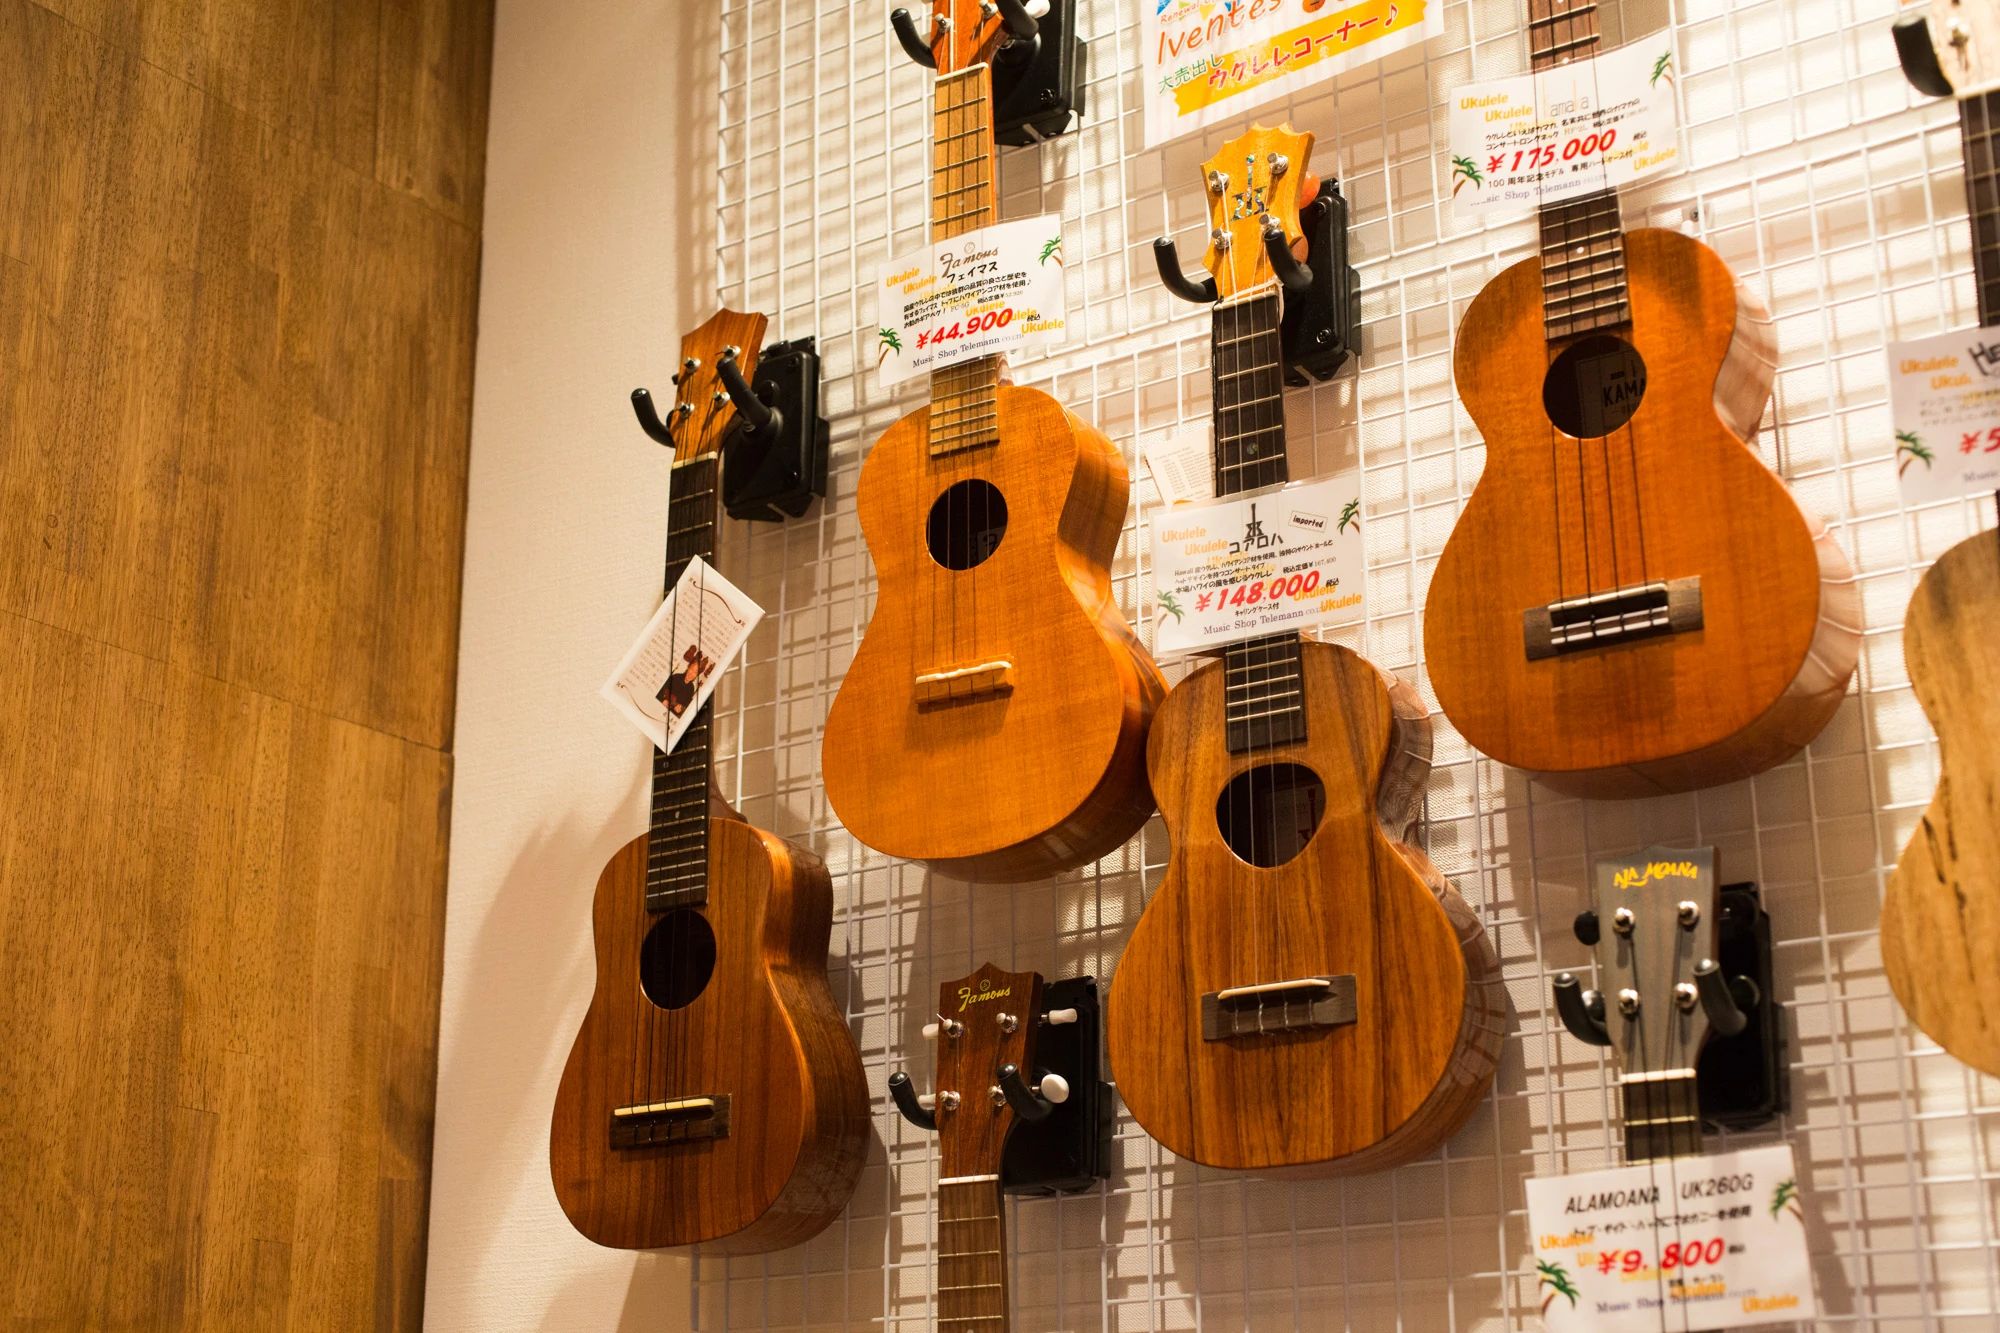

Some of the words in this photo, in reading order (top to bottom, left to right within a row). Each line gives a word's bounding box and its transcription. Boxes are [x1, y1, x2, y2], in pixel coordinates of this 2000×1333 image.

[1158, 53, 1224, 95] 大売出し
[1504, 188, 1530, 201] Shop
[1532, 179, 1582, 196] Telemann
[939, 247, 999, 279] Famous
[946, 261, 999, 284] フェイマス
[1020, 318, 1065, 335] Ukulele
[912, 354, 935, 369] Music
[937, 348, 958, 361] Shop
[960, 337, 1001, 354] Telemann
[1292, 514, 1324, 528] imported
[1228, 533, 1284, 555] コアロハ
[1203, 625, 1231, 636] Music
[1234, 618, 1257, 630] Shop
[1259, 609, 1304, 625] Telemann
[958, 985, 1011, 1013] Famous
[1565, 1185, 1660, 1215] ALAMOANA
[1681, 1173, 1754, 1201] UK260G
